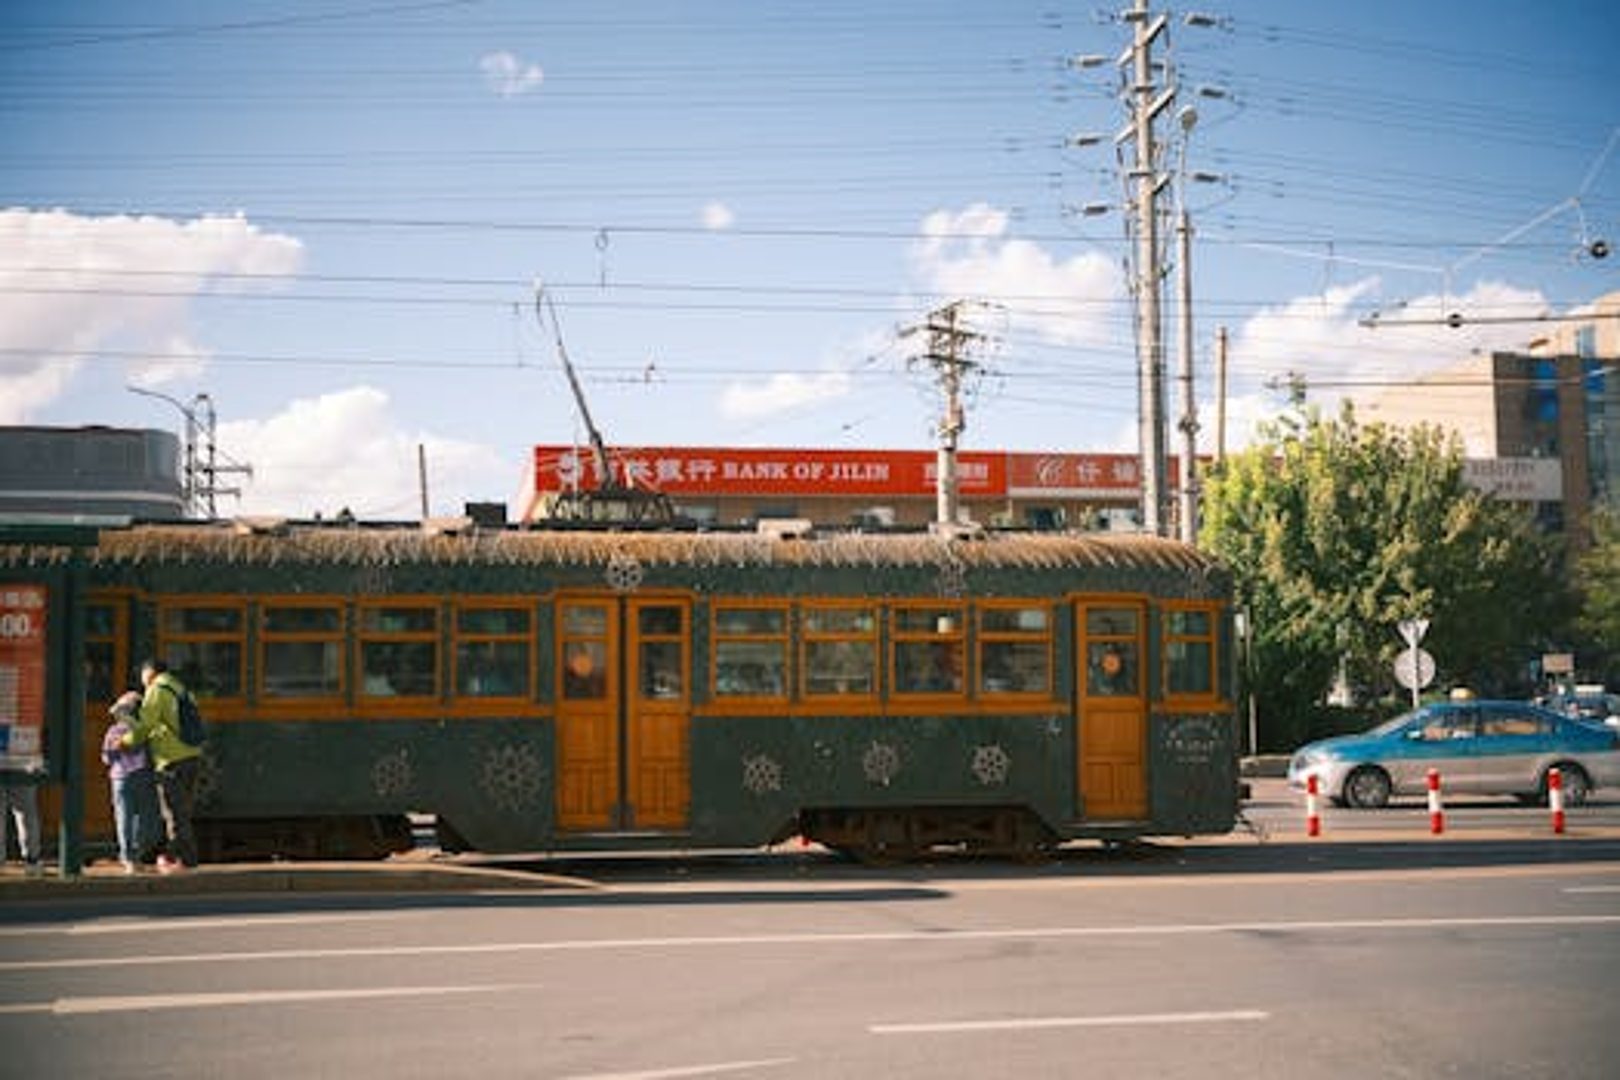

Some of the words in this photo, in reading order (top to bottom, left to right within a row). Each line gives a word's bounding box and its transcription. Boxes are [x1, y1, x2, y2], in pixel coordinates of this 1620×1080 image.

[722, 463, 788, 480] BANK
[793, 463, 824, 480] OF
[828, 463, 889, 481] JILIN
